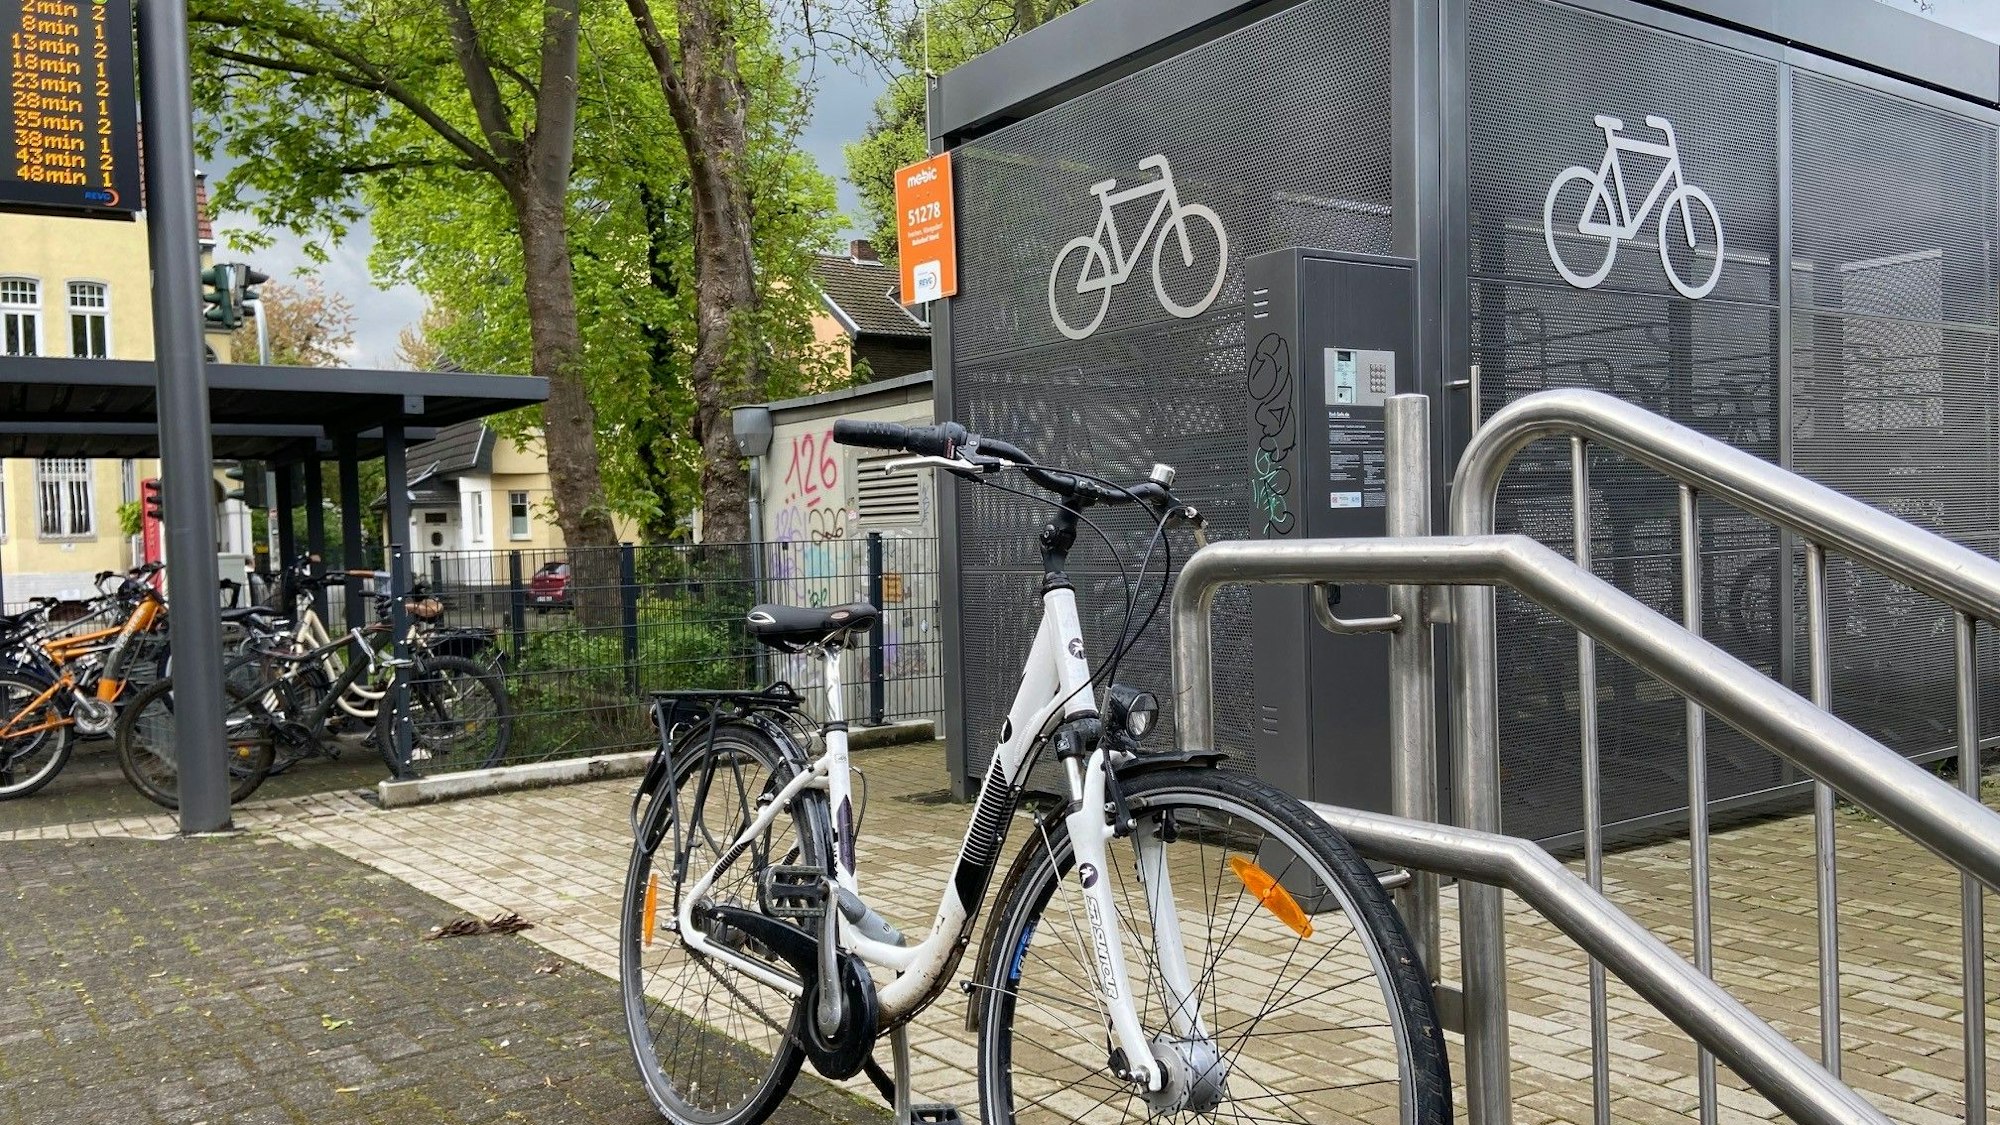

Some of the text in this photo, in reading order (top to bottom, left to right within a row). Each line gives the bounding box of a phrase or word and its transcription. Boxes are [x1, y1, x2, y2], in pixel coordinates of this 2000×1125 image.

[92, 5, 105, 21] 2
[23, 15, 104, 40] 8min 1
[12, 32, 107, 59] 13min 2
[13, 52, 106, 77] 18min 1
[12, 71, 109, 97] 23min 2
[13, 91, 108, 115] 28min 1
[14, 109, 111, 134] 35min 2
[15, 129, 110, 153] 38min 1
[16, 147, 113, 170] 43min 2
[17, 164, 112, 187] 48min 1
[908, 201, 941, 226] 51278
[785, 431, 837, 497] 126
